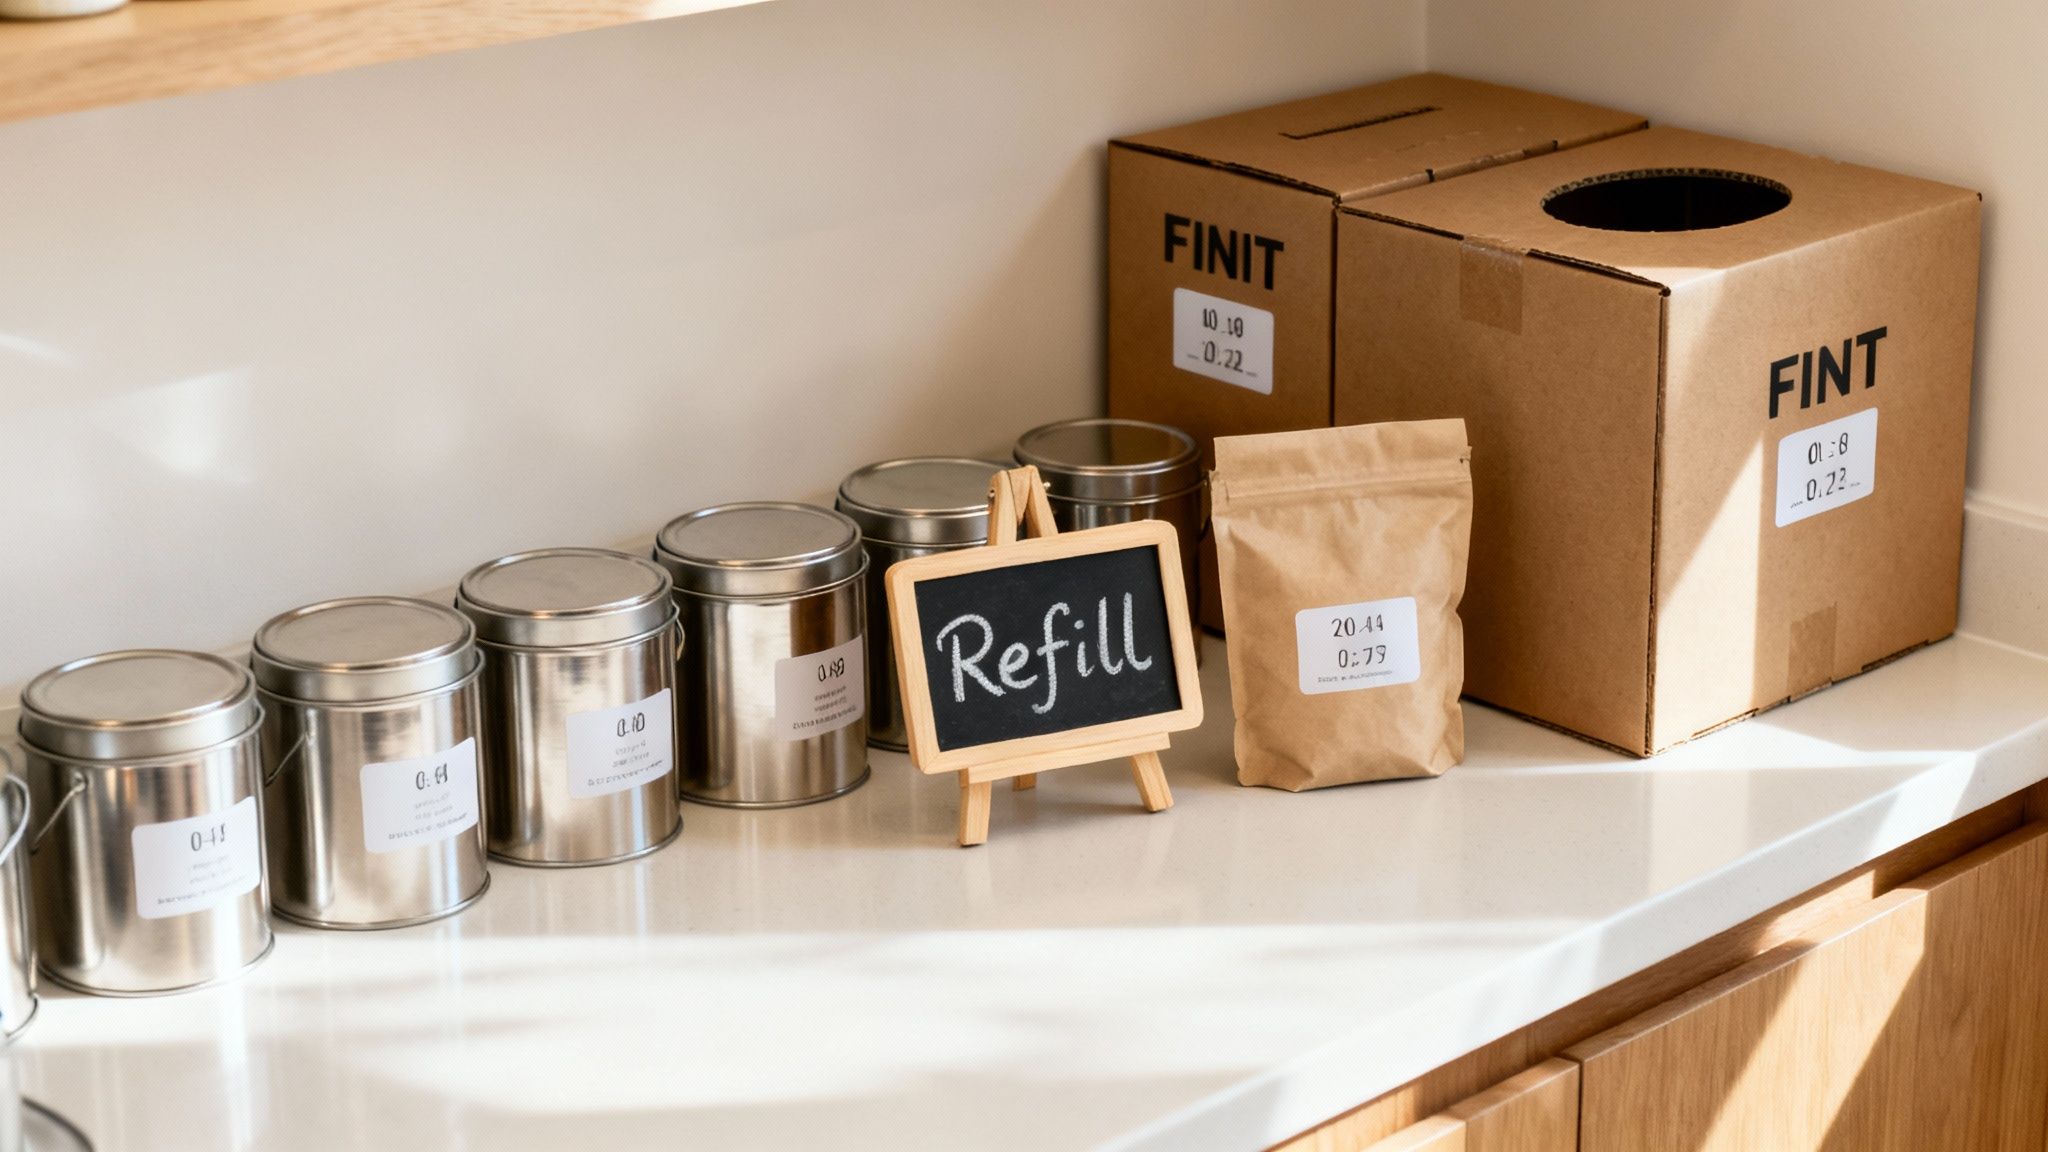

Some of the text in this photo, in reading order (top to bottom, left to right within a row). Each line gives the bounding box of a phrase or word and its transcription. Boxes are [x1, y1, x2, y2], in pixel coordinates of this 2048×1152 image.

[1164, 213, 1285, 291] FINIT
[1769, 326, 1888, 420] FINT
[936, 592, 1153, 715] Refill
